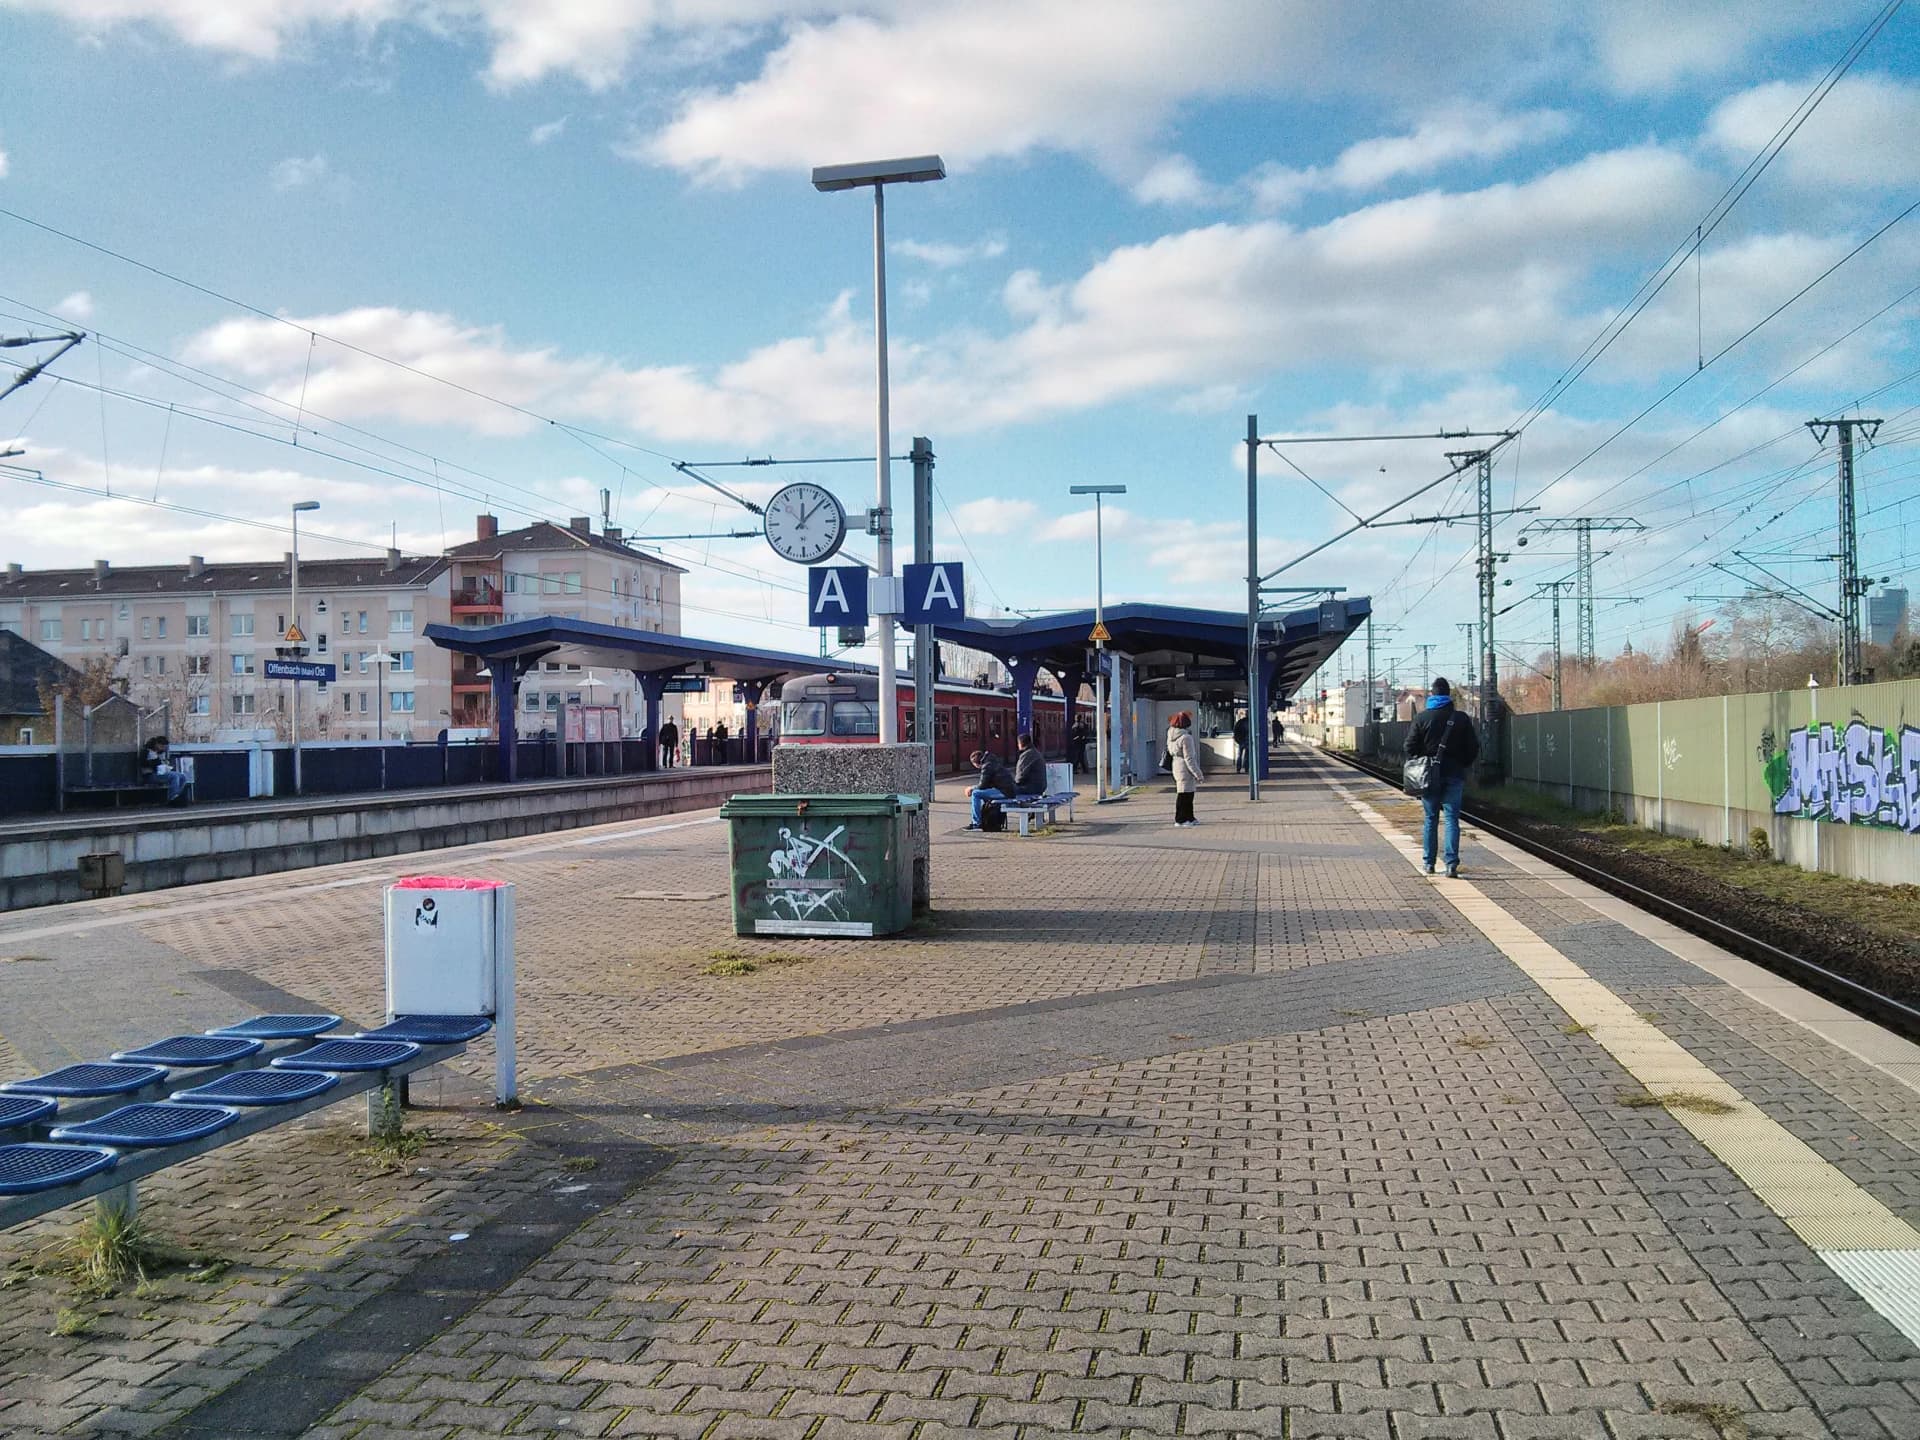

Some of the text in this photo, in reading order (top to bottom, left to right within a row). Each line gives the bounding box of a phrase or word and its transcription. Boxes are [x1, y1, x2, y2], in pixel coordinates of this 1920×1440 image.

[814, 569, 850, 613] A
[922, 565, 958, 611] A
[268, 663, 300, 675] Offenbach
[315, 666, 326, 677] Ost
